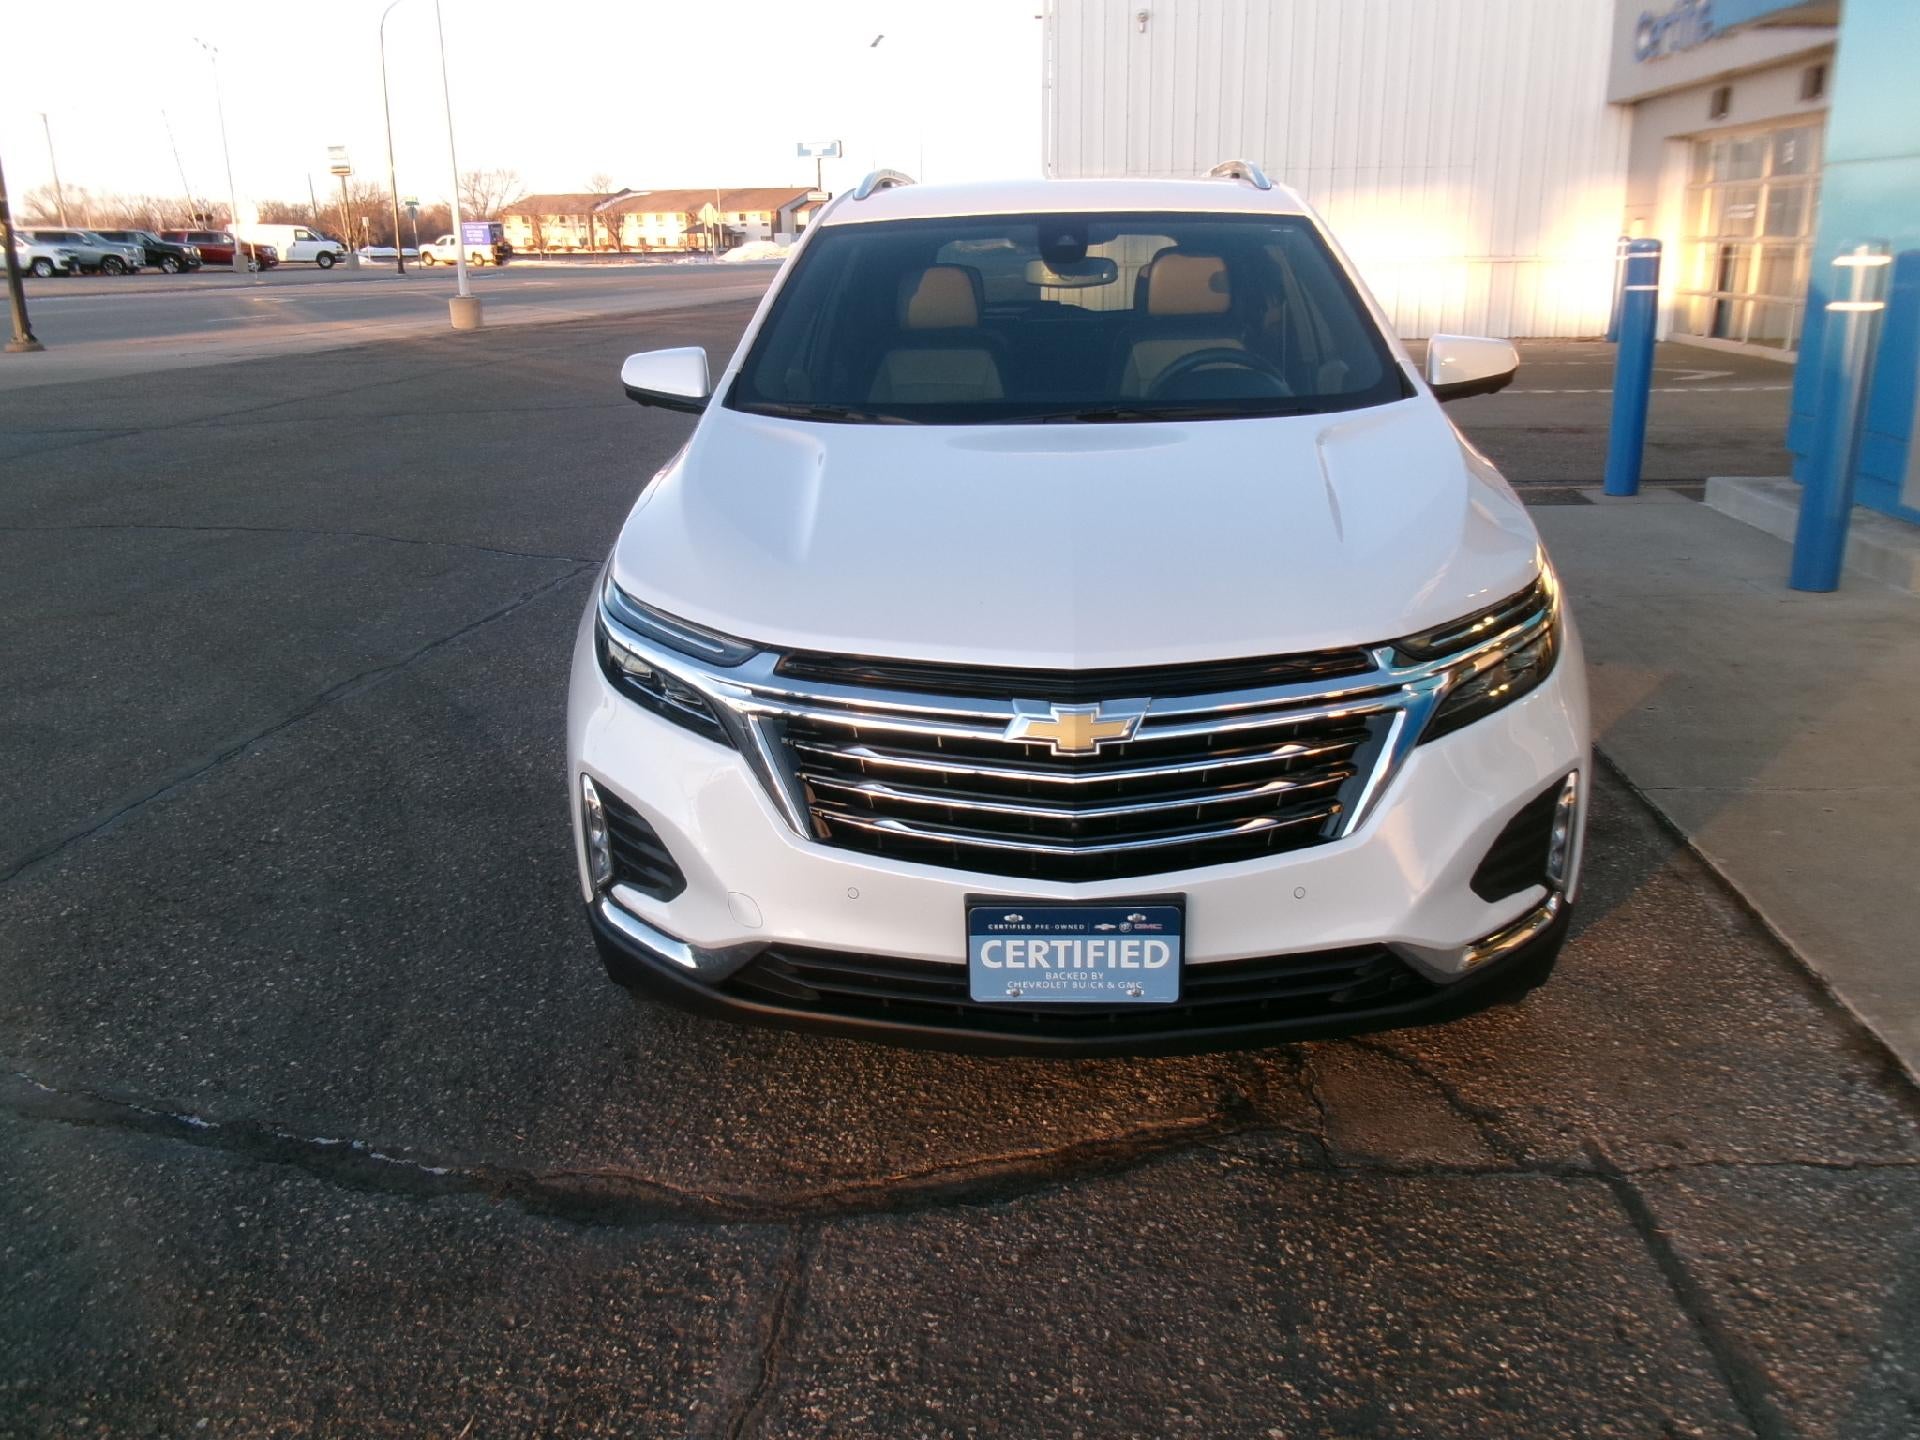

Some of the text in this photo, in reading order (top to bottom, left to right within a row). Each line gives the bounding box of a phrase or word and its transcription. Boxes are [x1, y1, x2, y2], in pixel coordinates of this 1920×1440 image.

[980, 940, 1170, 969] CERTIFIED
[1045, 972, 1104, 980] BACKED BY
[1007, 981, 1068, 989] CHEVROLET
[1072, 981, 1104, 989] BUICK
[1117, 981, 1144, 989] GMC
